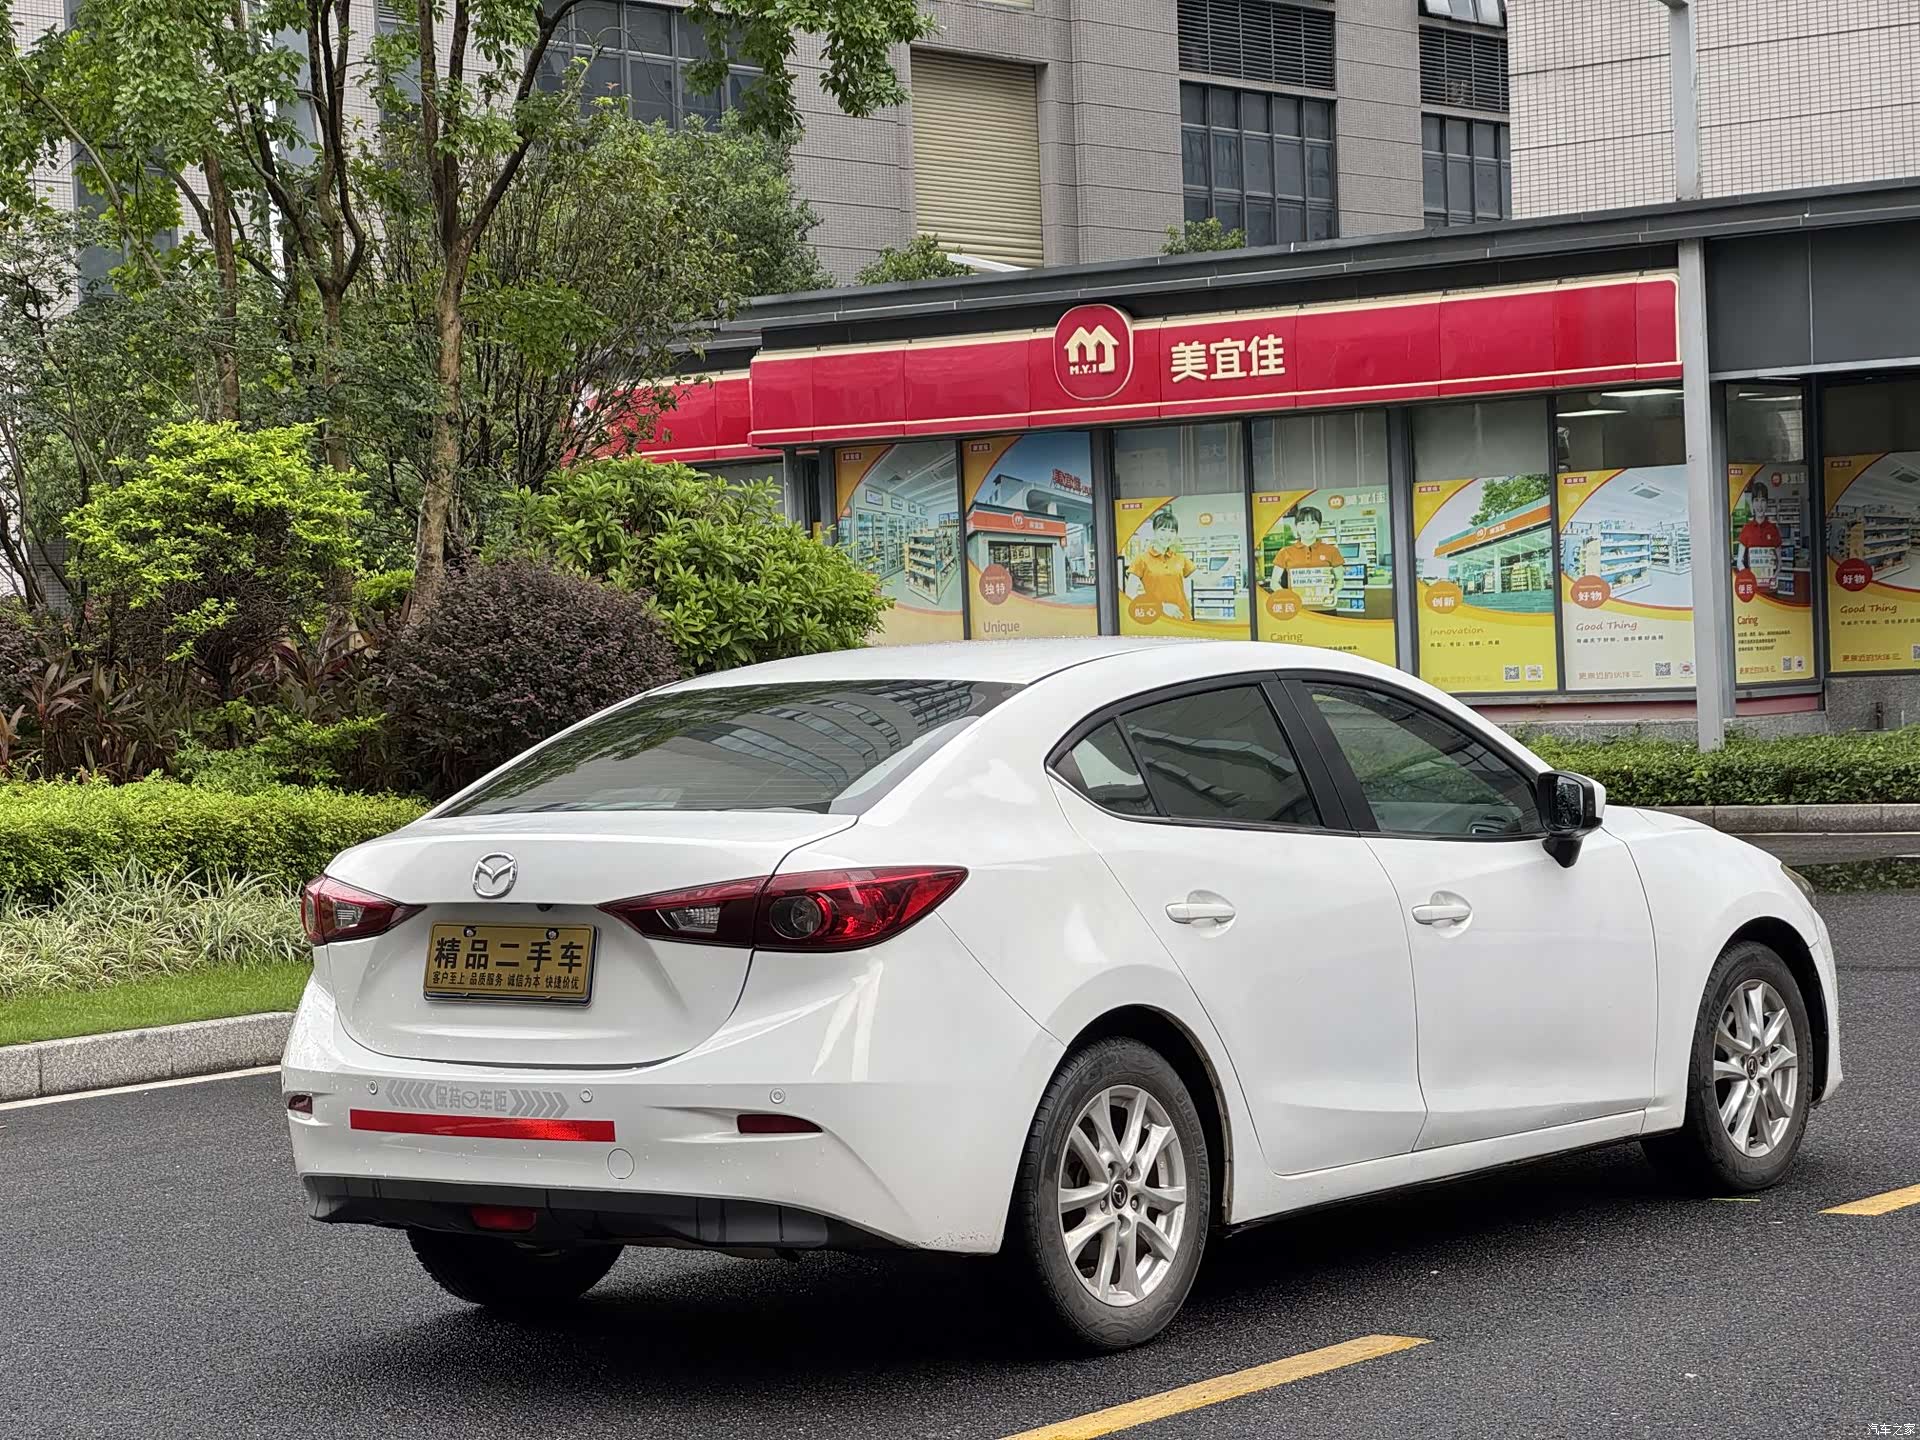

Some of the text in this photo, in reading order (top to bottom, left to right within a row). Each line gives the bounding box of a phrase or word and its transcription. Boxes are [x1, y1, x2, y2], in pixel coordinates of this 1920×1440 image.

[1170, 333, 1286, 383] 美宜佳
[1842, 574, 1866, 585] 好物
[984, 582, 1006, 595] 独特
[1432, 596, 1455, 607] 创新
[1577, 590, 1603, 602] 好物
[1272, 603, 1296, 613] 便民
[1840, 603, 1898, 614] Good Thing
[1576, 621, 1638, 632] Good Thing
[1737, 615, 1759, 627] Caring
[983, 620, 1020, 635] Unique
[1430, 625, 1484, 636] Innovation
[1270, 632, 1304, 643] Caring
[434, 937, 584, 973] 精品二手车
[432, 970, 580, 990] 客户至上 品质服务 诚信为本 快捷价优
